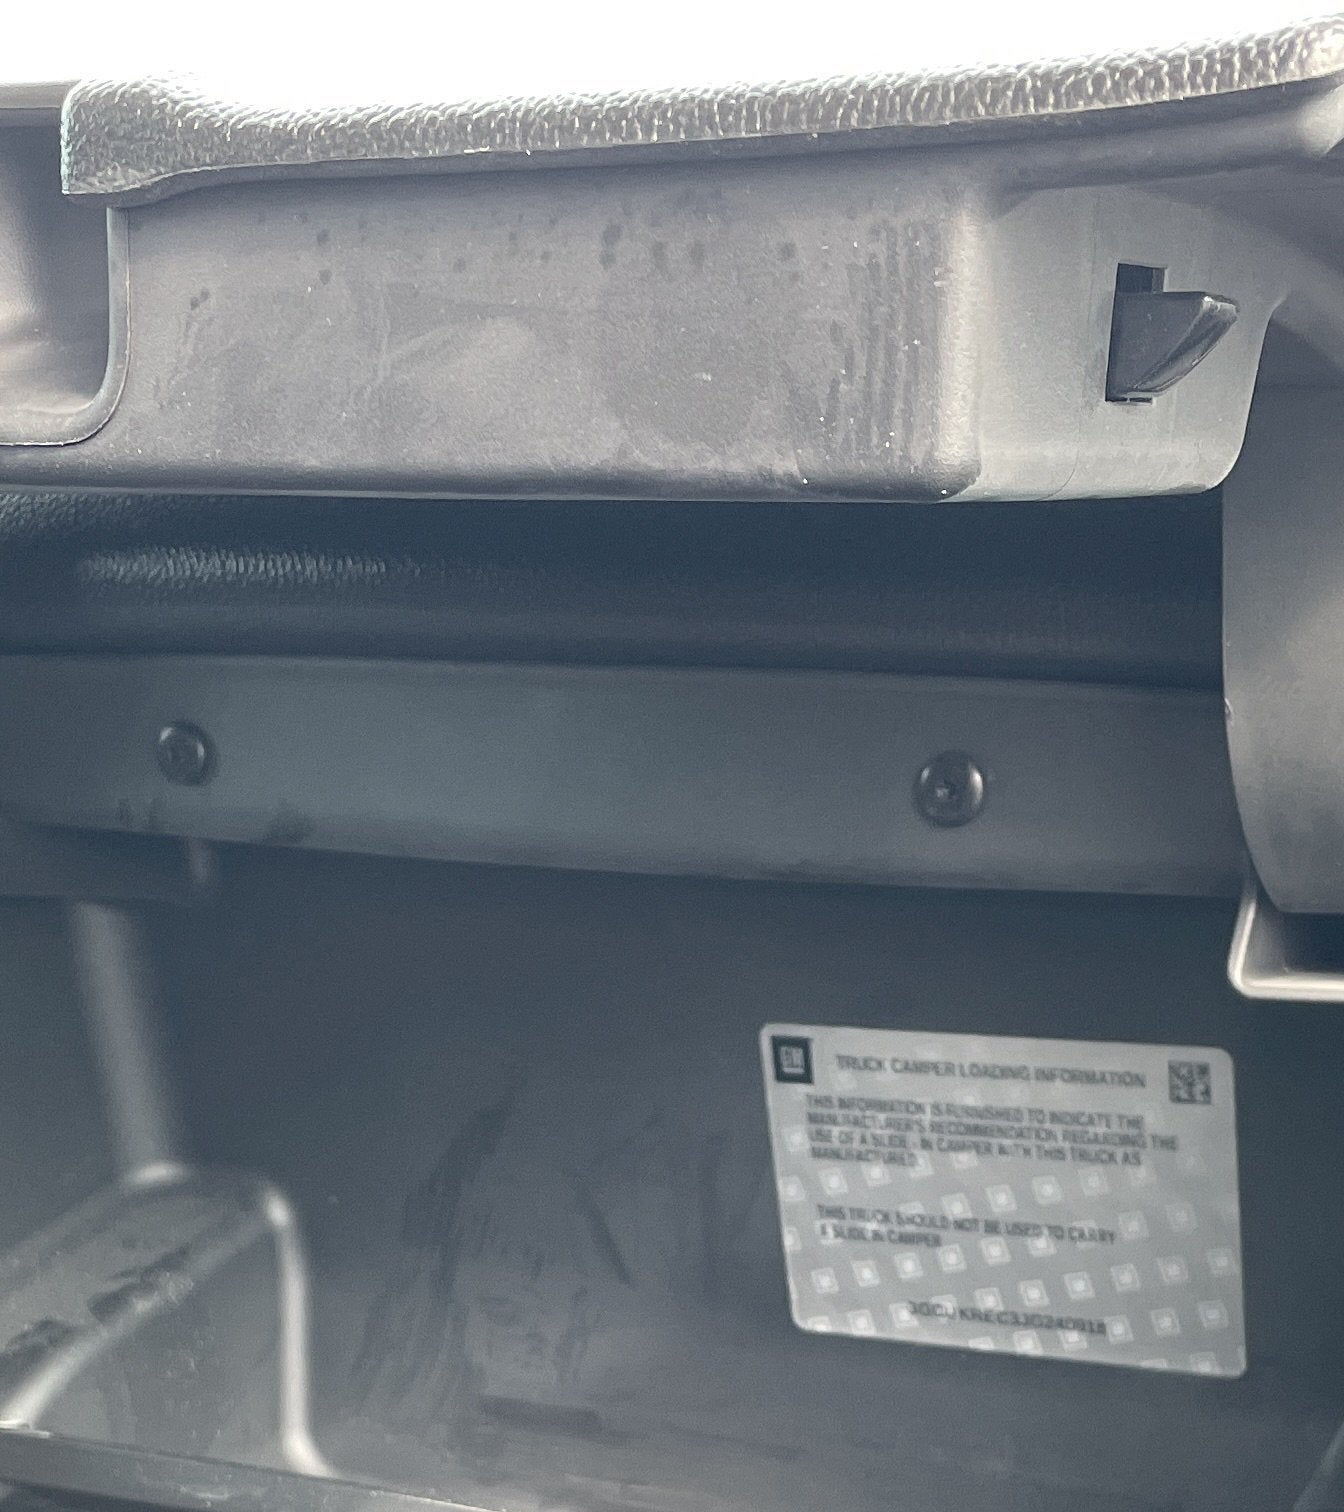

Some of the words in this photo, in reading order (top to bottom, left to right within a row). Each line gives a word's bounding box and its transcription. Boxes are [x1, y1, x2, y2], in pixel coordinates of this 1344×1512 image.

[836, 1056, 885, 1073] TRUCK
[890, 1059, 957, 1076] CAMPER
[959, 1063, 1031, 1080] LOADING
[1034, 1066, 1146, 1086] INFORMATION
[838, 1098, 926, 1116] INFORMATION
